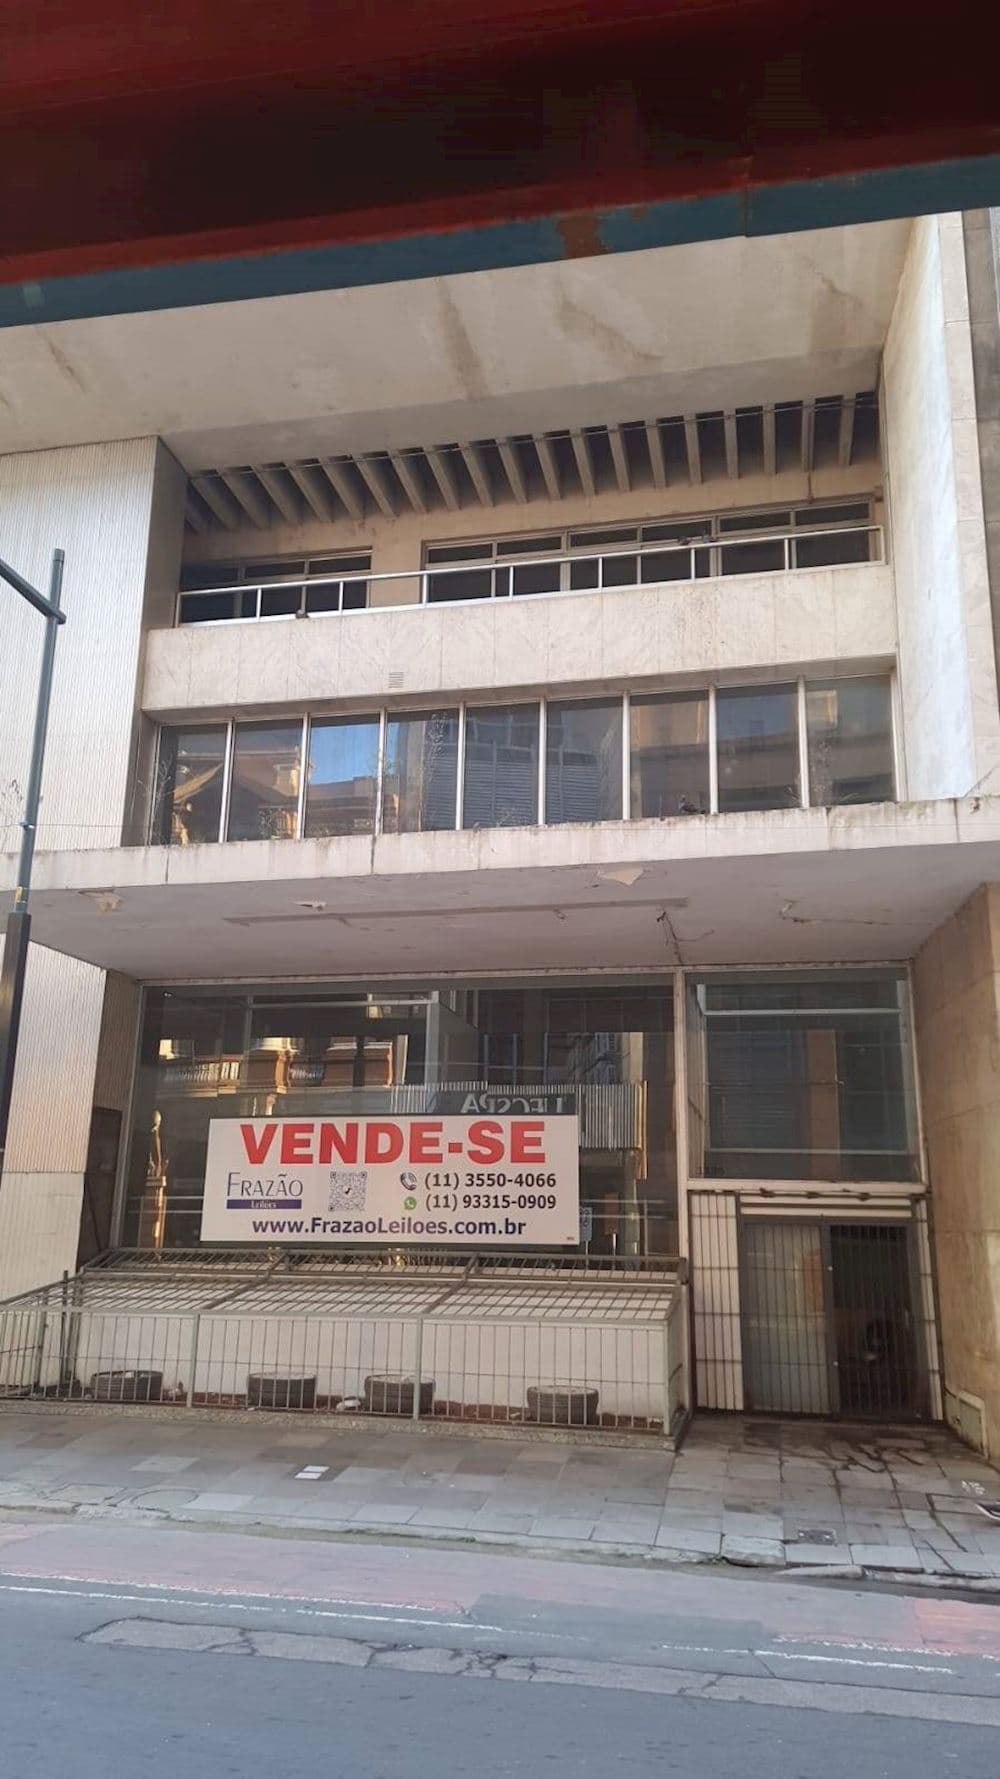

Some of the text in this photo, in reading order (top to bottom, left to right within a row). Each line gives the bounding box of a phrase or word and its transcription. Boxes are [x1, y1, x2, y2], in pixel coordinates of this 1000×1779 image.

[240, 1120, 546, 1165] VENDE-SE
[226, 1172, 304, 1197] FRAZÃO
[424, 1172, 557, 1190] (11) 3550-4066
[425, 1193, 557, 1212] (11) 93315-0909
[252, 1217, 527, 1236] www.FrazaoLeiloes.com.br
